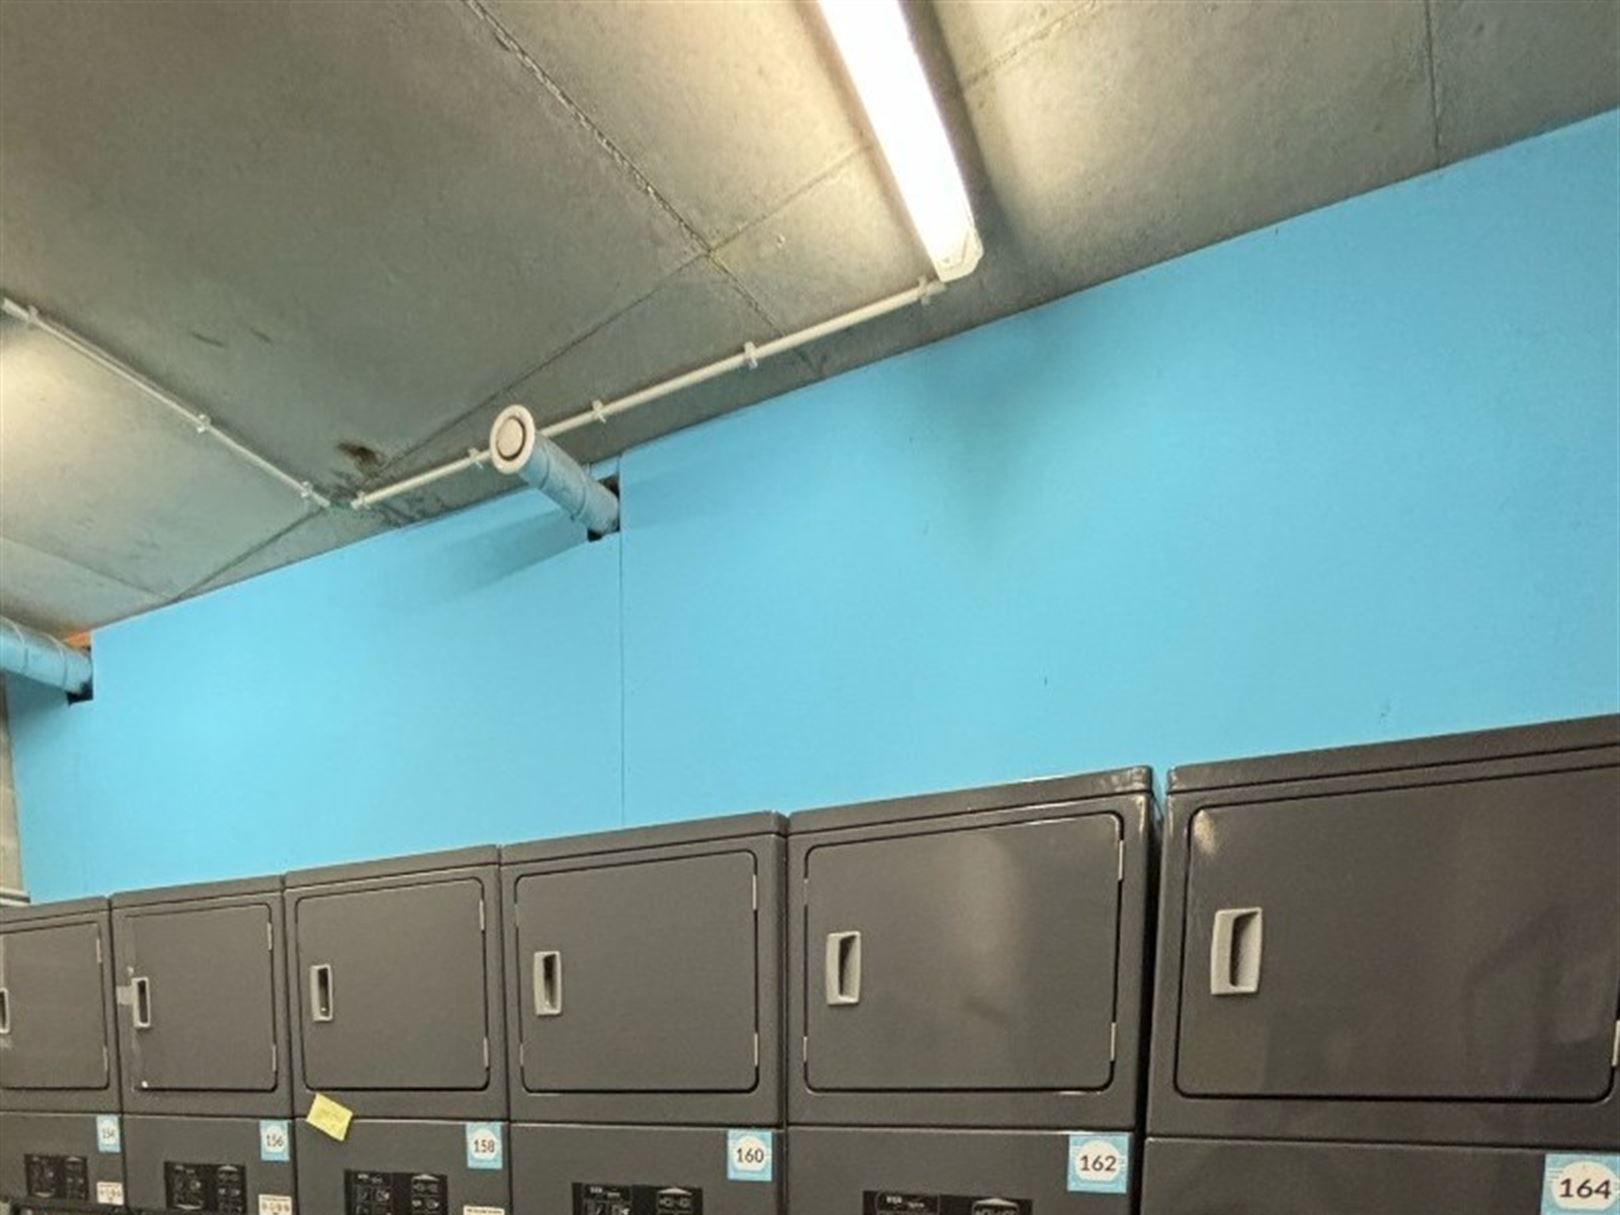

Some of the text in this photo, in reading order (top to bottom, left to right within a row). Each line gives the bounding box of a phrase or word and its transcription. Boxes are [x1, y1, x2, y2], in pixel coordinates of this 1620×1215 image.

[266, 1133, 283, 1148] 156
[473, 1138, 495, 1154] 158
[736, 1147, 764, 1164] 160
[1080, 1154, 1117, 1172] 162
[1559, 1177, 1611, 1200] 164
